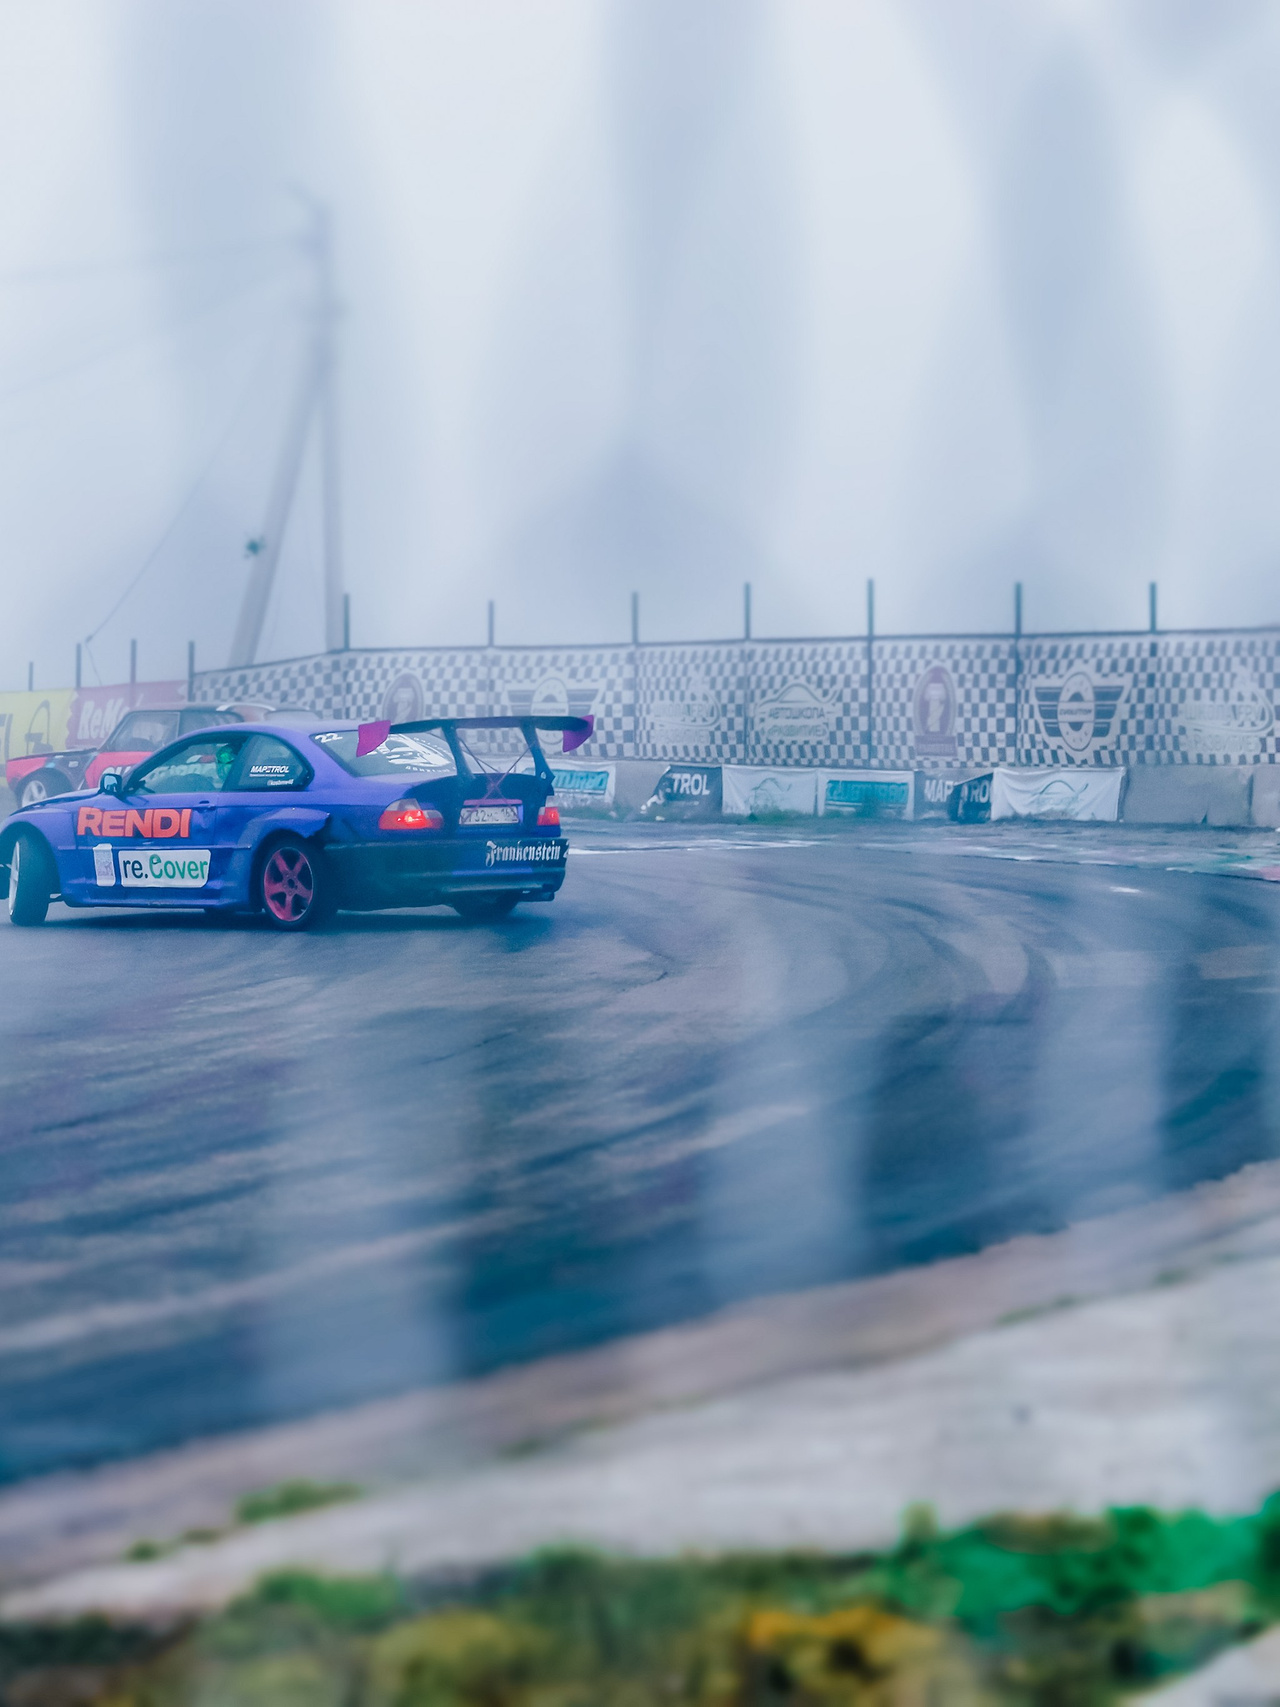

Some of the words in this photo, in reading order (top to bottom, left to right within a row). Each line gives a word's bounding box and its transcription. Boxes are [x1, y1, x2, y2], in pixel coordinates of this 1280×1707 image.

[768, 706, 826, 720] АВТОШКОЛА
[1059, 708, 1092, 716] EVOLUTION
[314, 732, 343, 743] 22
[250, 765, 290, 774] MAPETROL
[77, 806, 192, 838] RENDI
[486, 840, 561, 867] Frankenstein
